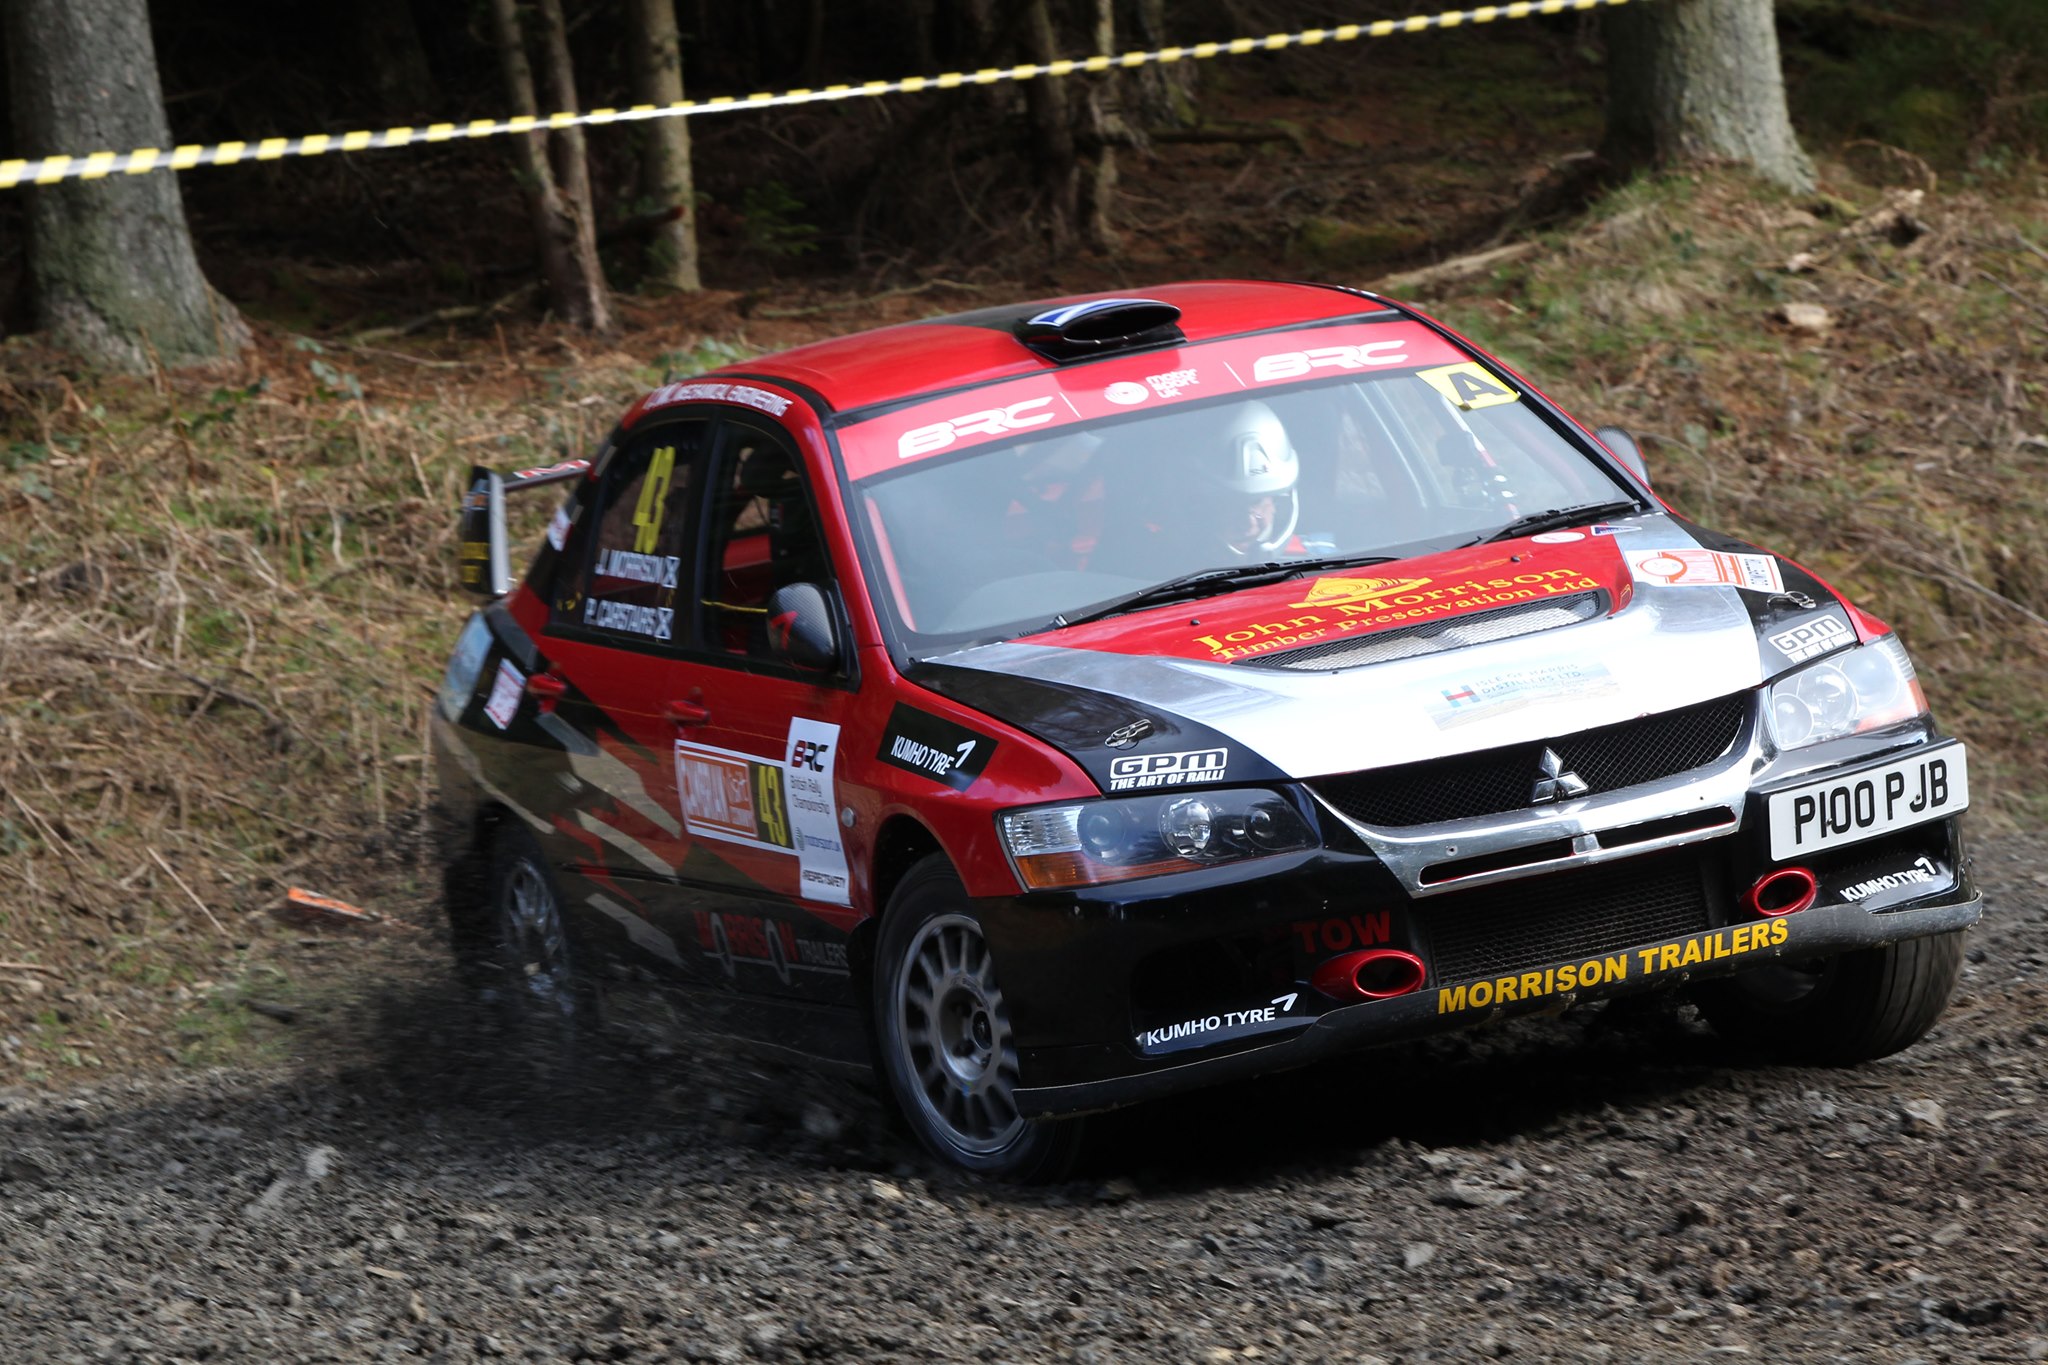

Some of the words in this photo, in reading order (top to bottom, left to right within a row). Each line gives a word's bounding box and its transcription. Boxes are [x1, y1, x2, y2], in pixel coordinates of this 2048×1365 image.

[1253, 340, 1408, 382] BRC
[1157, 387, 1182, 398] UK
[1447, 371, 1510, 402] A
[898, 396, 1055, 458] BRC
[1192, 611, 1327, 649] John
[1332, 569, 1582, 616] Morrison
[1212, 627, 1337, 661] Timber
[1337, 587, 1537, 632] Preservation
[1541, 576, 1601, 593] Ltd
[1773, 618, 1842, 650] GPM
[1481, 675, 1554, 695] DISTILLERS
[791, 740, 829, 772] BRC
[891, 735, 929, 767] KUMHO
[926, 746, 956, 776] TYRE
[1112, 749, 1227, 778] GPM
[1110, 777, 1136, 791] THE
[1136, 774, 1165, 788] ART
[1167, 772, 1184, 785] OF
[1185, 769, 1226, 783] RALLI
[758, 765, 788, 847] 43
[1794, 780, 1876, 845] P100
[1885, 759, 1949, 821] PJB
[1840, 876, 1897, 902] KUMHO
[1897, 866, 1931, 887] TYRE
[693, 910, 799, 986] MORRISON
[796, 938, 850, 968] TRAILERS
[1293, 910, 1391, 954] TOW
[1437, 953, 1628, 1015] MORRISON
[1637, 917, 1789, 975] TRAILERS
[1146, 1015, 1221, 1047] KUMHO
[1223, 1006, 1276, 1026] TYRE
